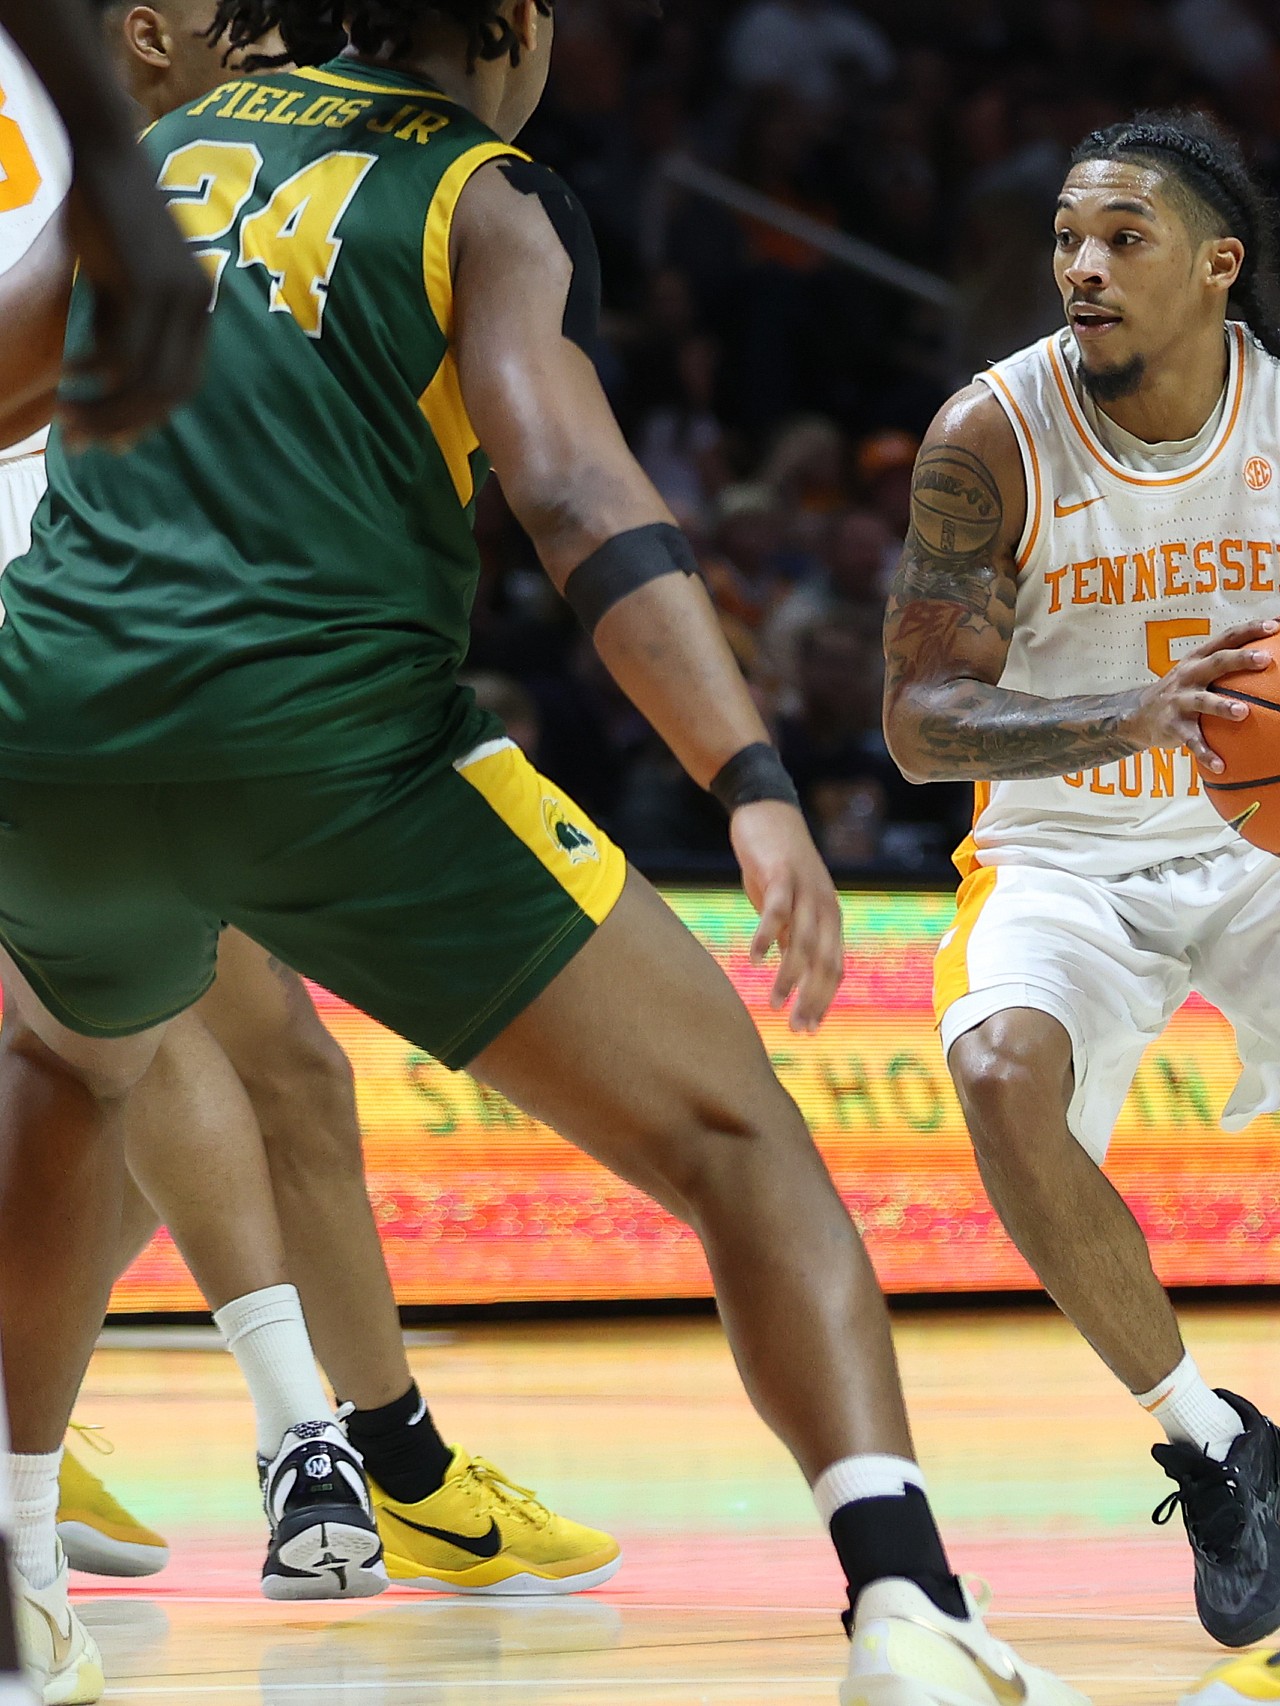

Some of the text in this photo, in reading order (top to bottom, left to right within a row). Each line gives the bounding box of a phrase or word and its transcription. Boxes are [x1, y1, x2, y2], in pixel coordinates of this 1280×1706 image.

[187, 80, 450, 144] FIELDS JR
[157, 139, 378, 339] 24
[1246, 459, 1270, 487] SEC
